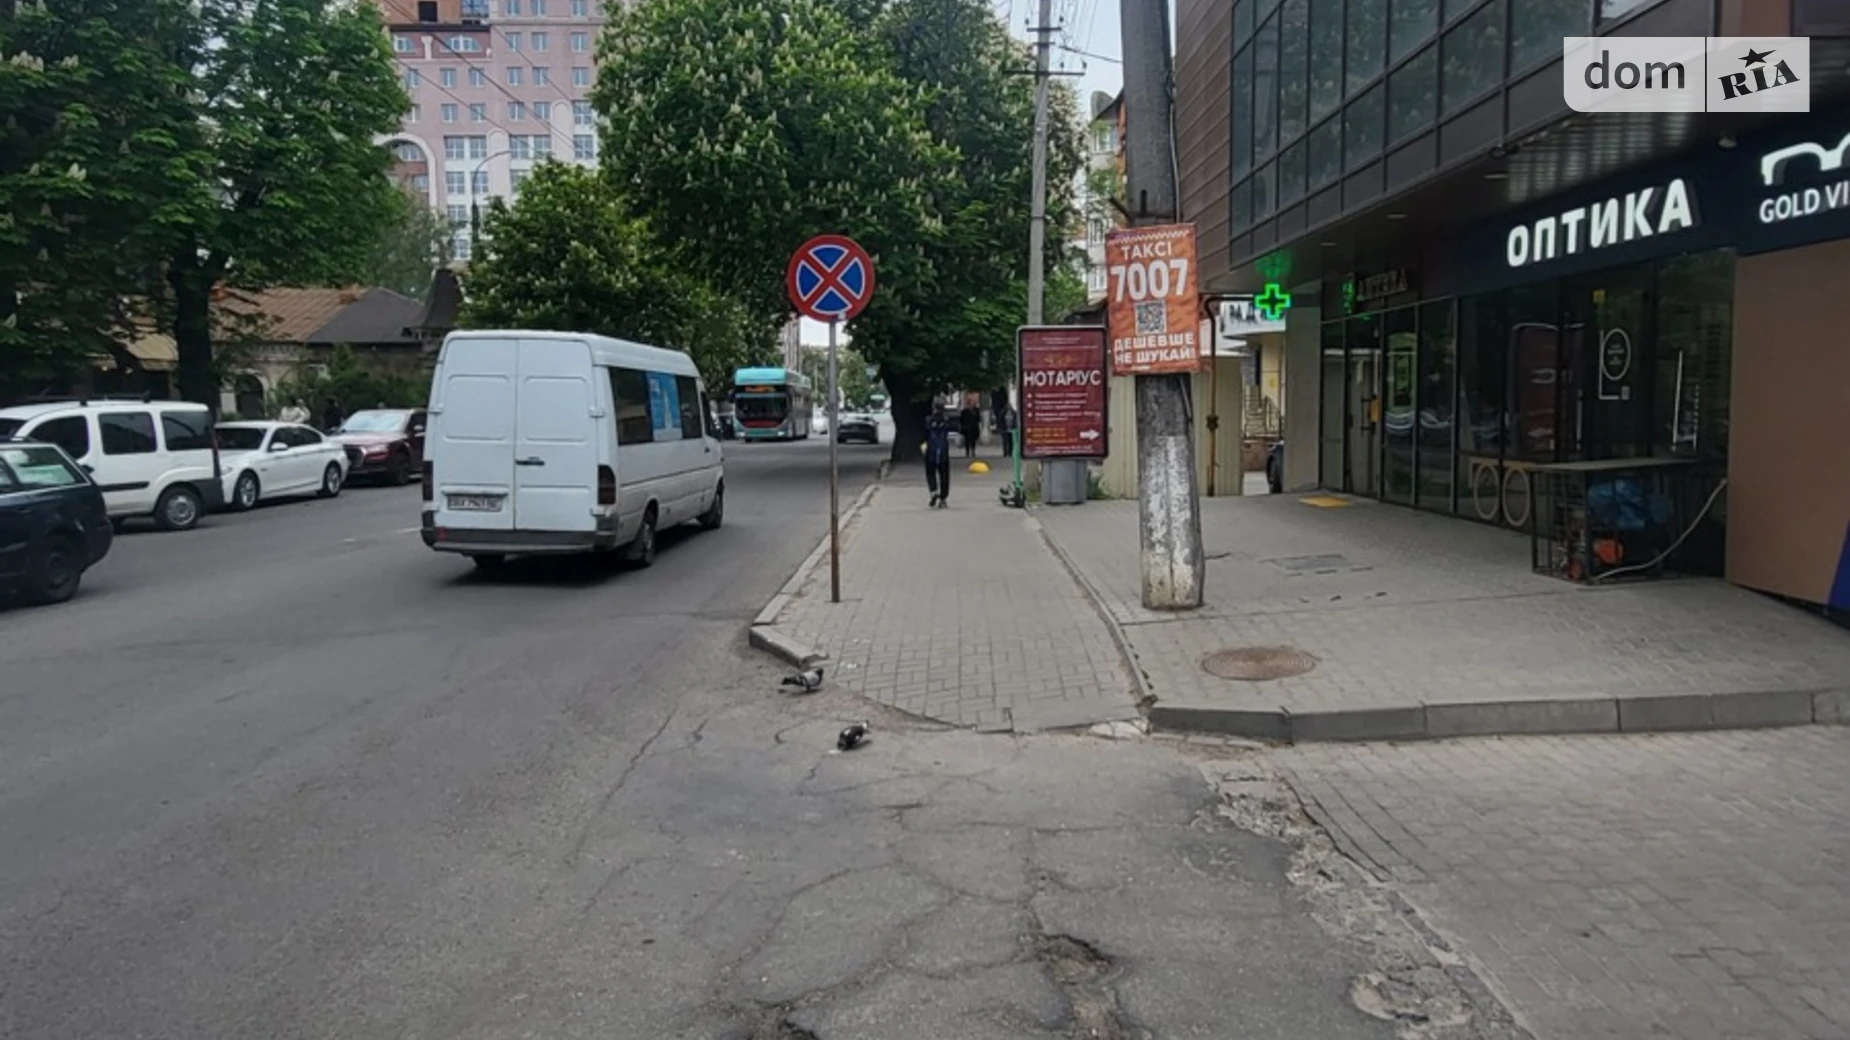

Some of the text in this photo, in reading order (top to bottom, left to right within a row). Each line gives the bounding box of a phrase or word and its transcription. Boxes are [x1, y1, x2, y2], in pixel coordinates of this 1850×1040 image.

[1759, 188, 1820, 223] GOLD
[1507, 178, 1692, 267] ОПТИКА
[1121, 241, 1172, 260] ТАКСІ
[1110, 259, 1188, 303] 7007
[1114, 332, 1195, 351] ДЕШЕВШЕ
[1114, 345, 1196, 365] НЕ ШУКАЙ!
[1023, 369, 1102, 387] НОТАРІУС
